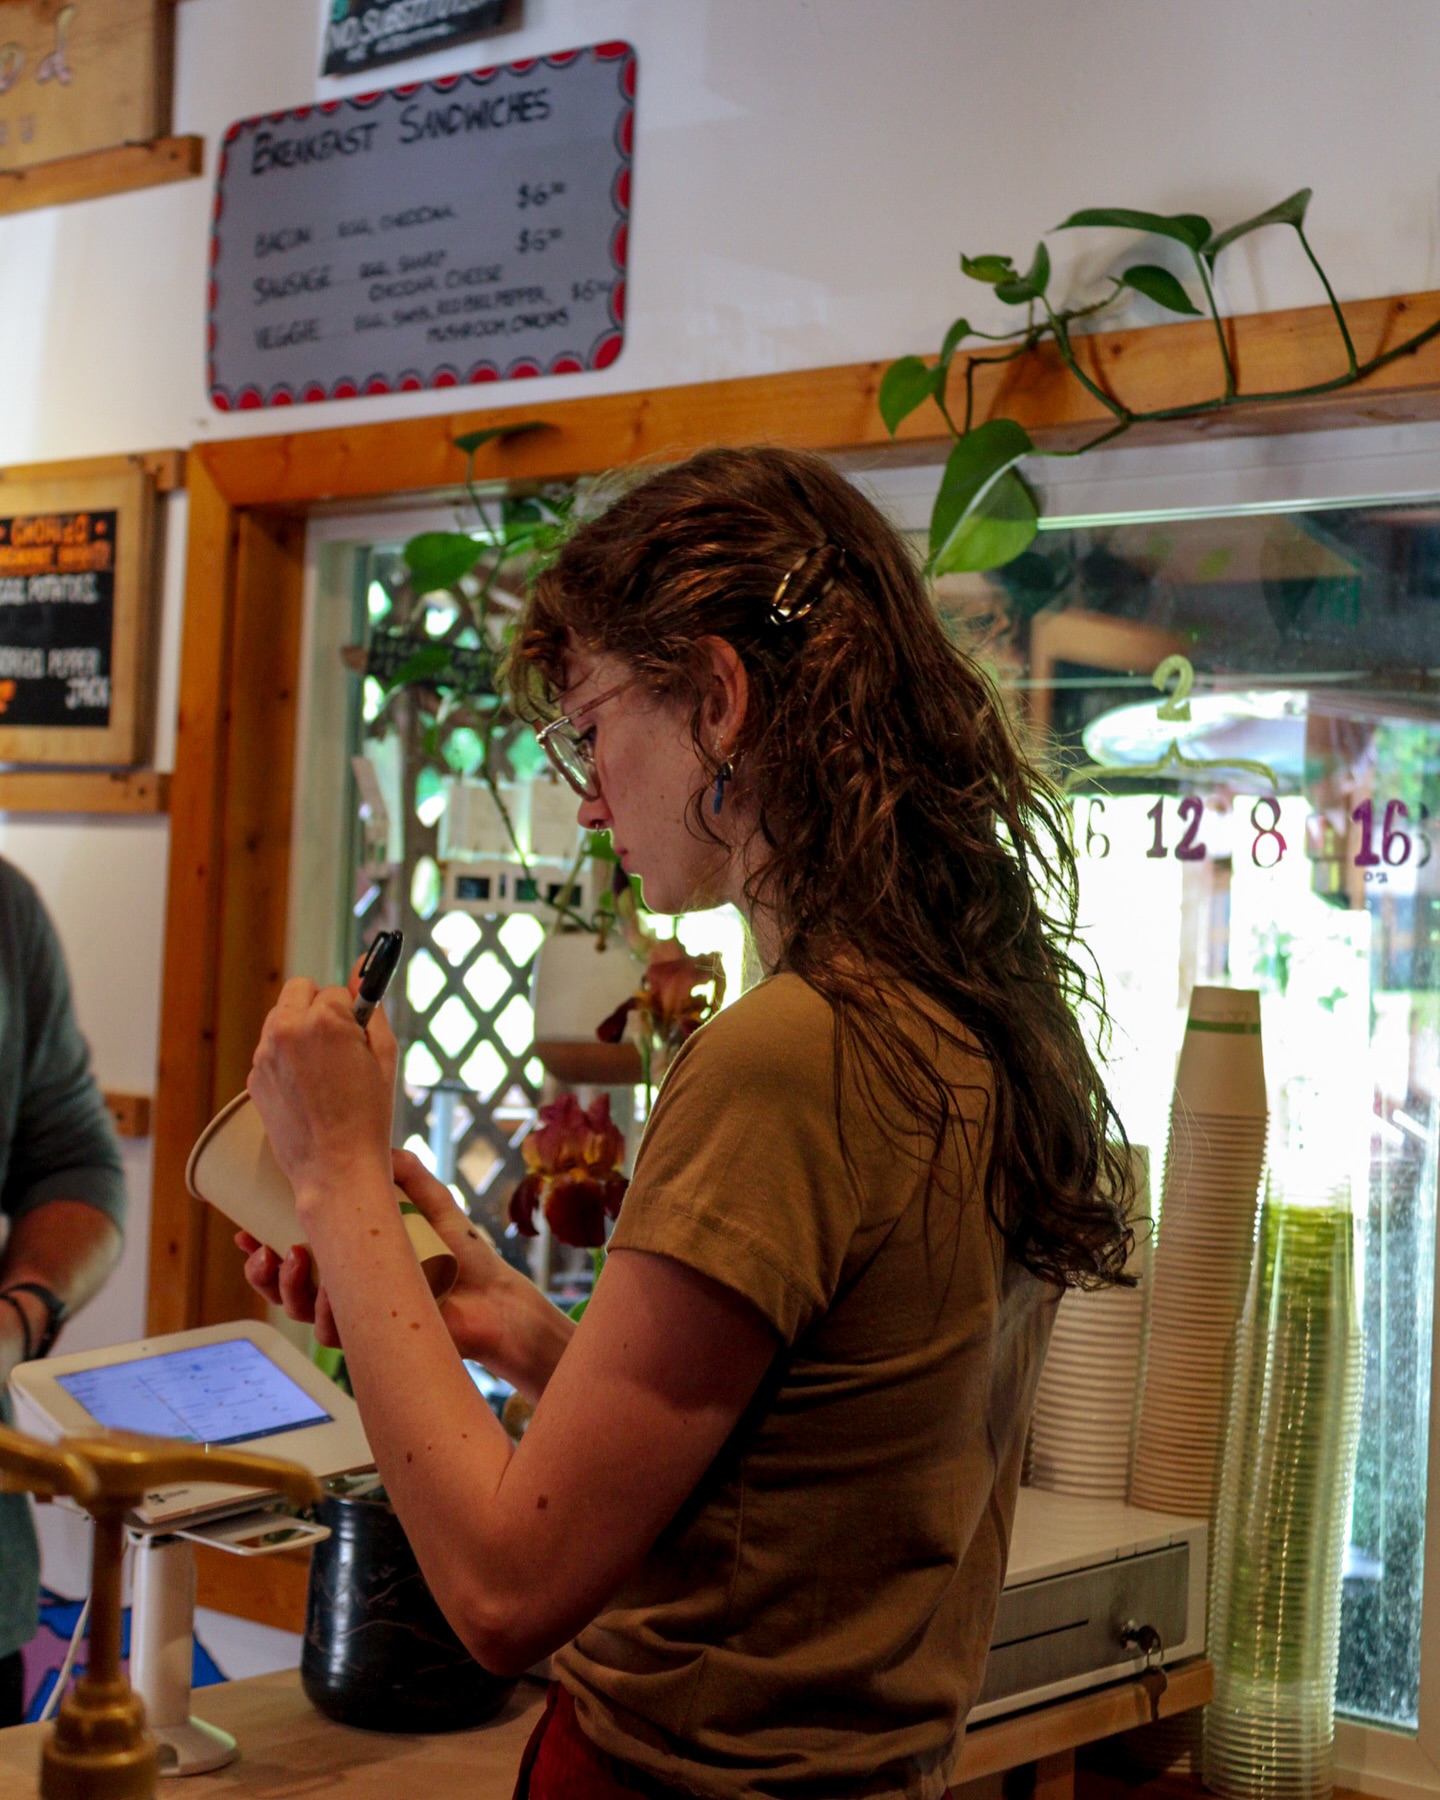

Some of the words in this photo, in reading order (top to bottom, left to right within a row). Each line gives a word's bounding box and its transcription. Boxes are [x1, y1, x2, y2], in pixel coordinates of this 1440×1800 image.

[252, 122, 379, 175] BREAKFAST
[398, 88, 550, 143] SANDWICHES
[1146, 795, 1207, 862] 12
[1250, 796, 1287, 869] 8
[1352, 798, 1412, 867] 16
